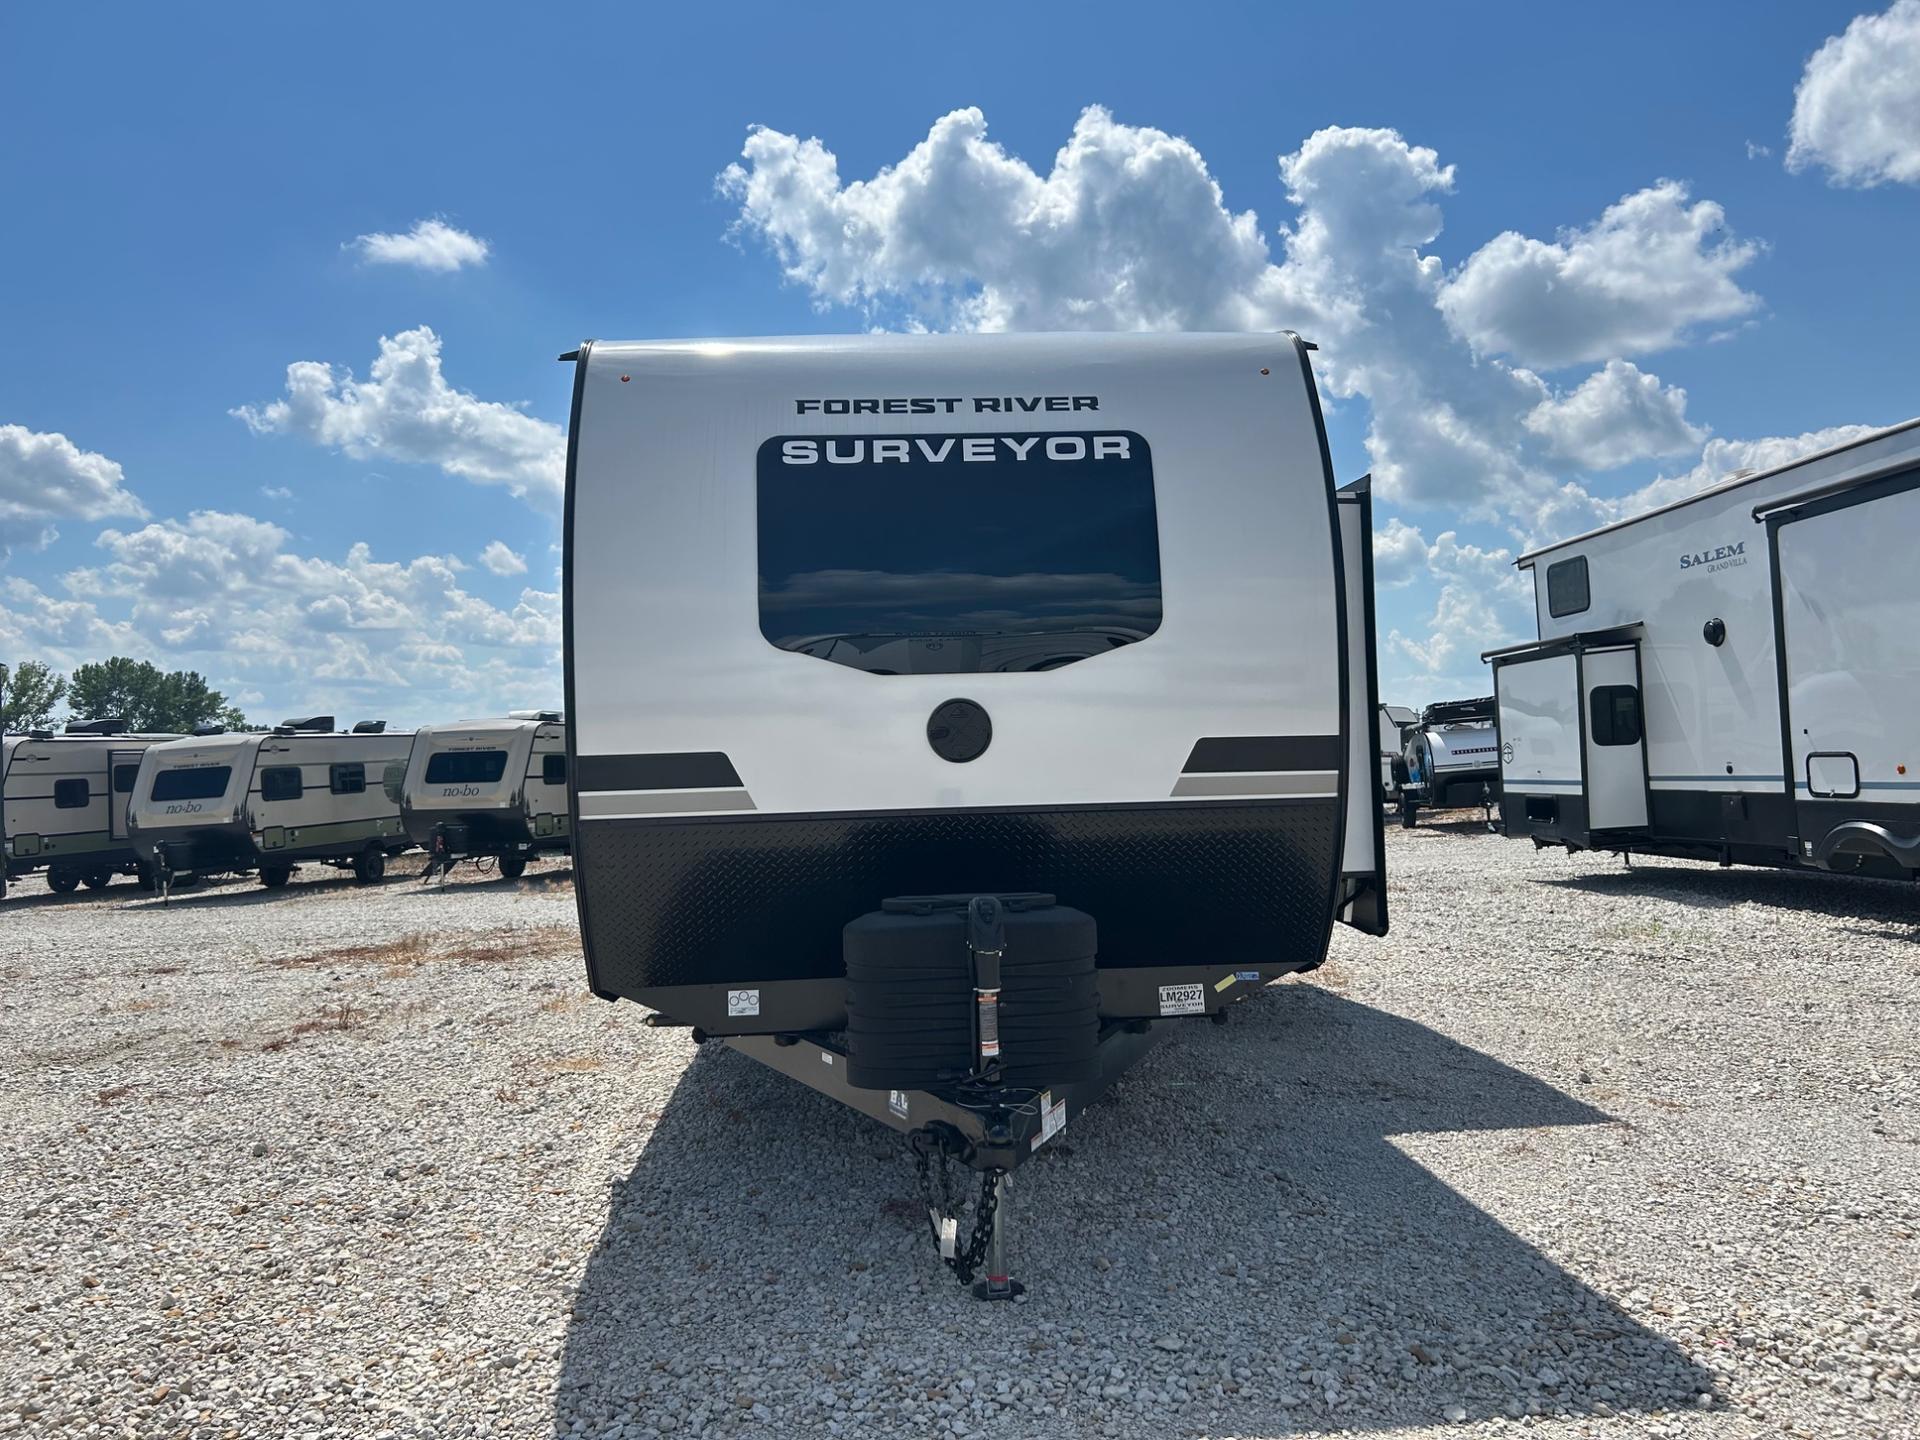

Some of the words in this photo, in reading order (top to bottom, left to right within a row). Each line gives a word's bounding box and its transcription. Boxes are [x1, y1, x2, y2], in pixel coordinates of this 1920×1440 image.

[795, 398, 962, 414] FOREST
[973, 396, 1100, 412] RIVER
[781, 436, 1131, 465] SURVEYOR
[1680, 541, 1745, 569] SALEM
[1160, 990, 1202, 1002] LM2927
